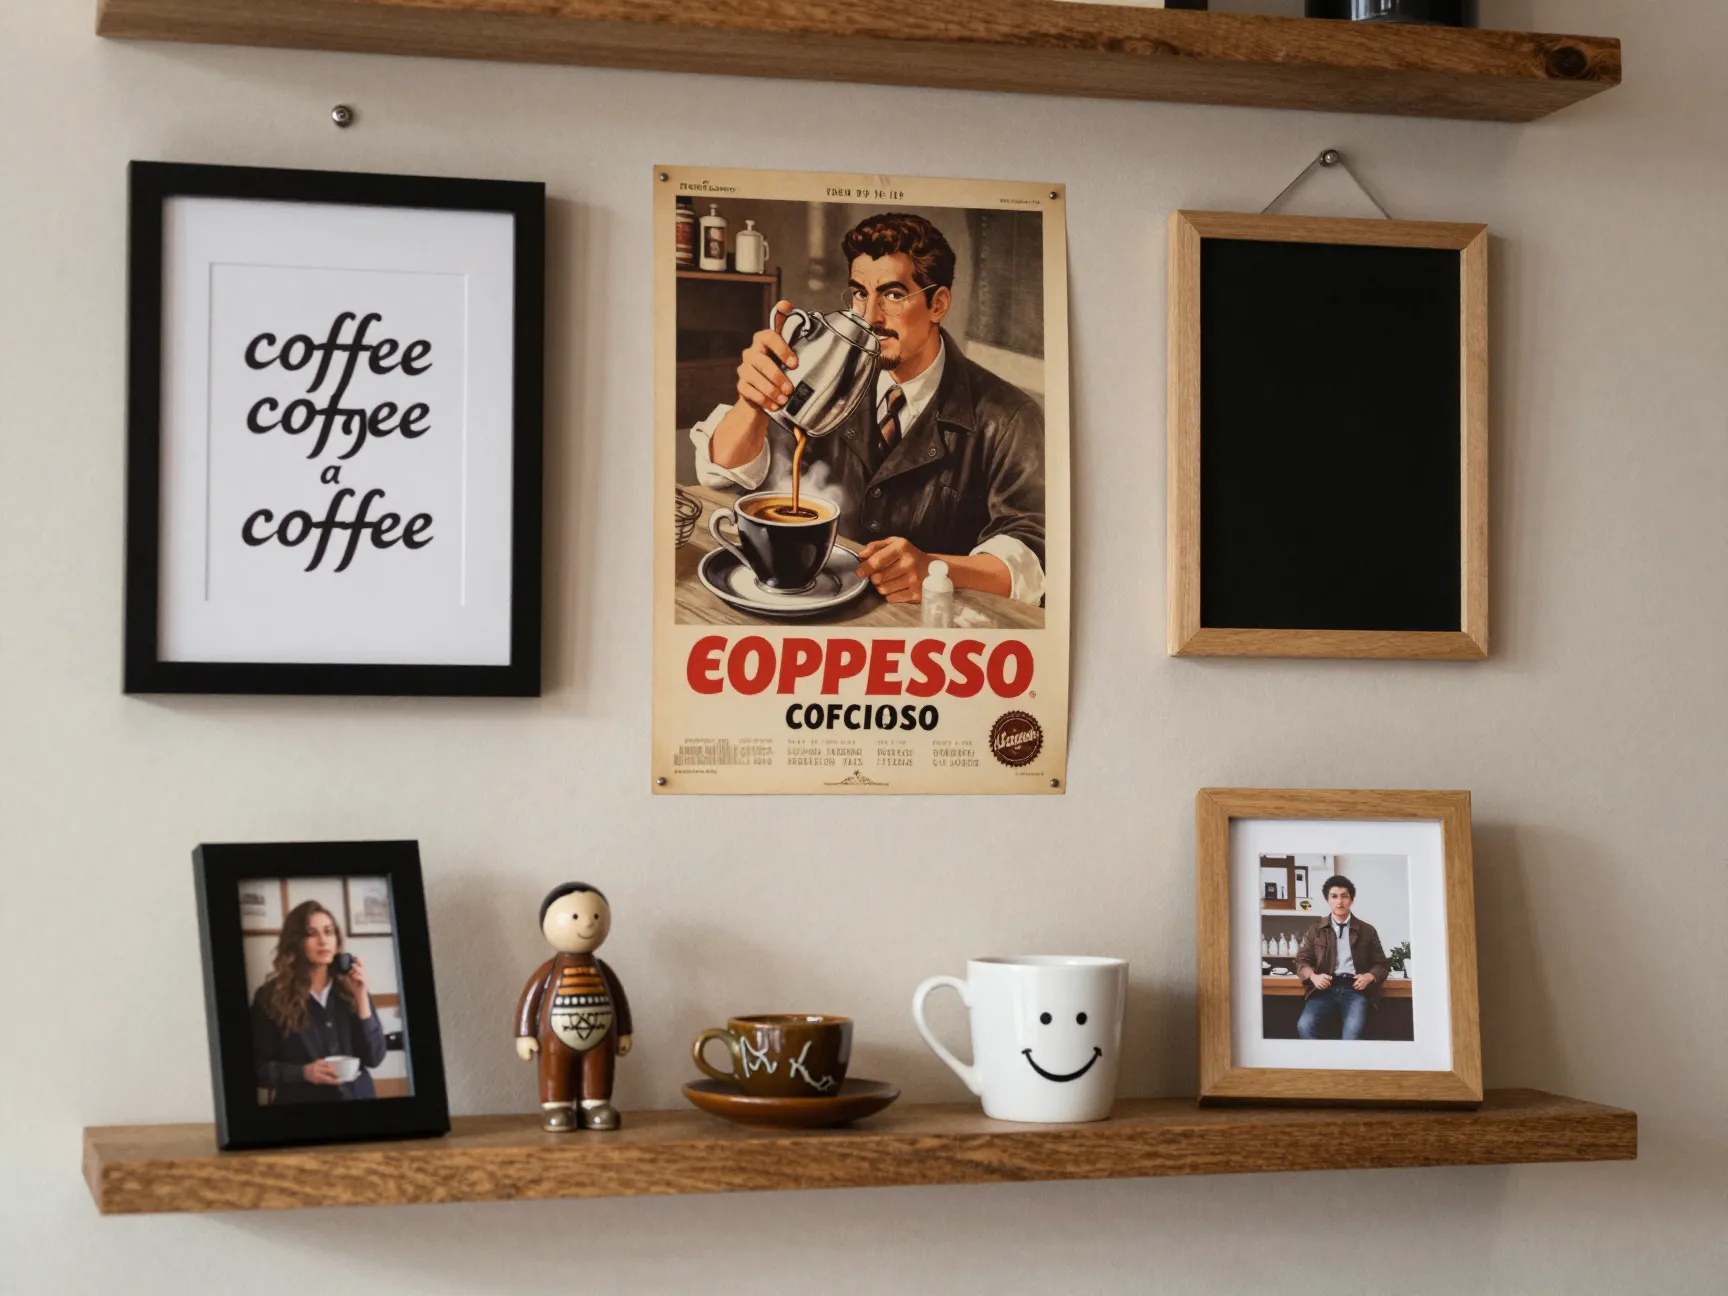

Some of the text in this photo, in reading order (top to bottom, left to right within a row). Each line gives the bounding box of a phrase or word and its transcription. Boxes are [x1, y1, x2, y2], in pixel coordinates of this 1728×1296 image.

[245, 311, 432, 394] coffee
[320, 465, 341, 484] a
[242, 487, 433, 573] coffee
[686, 634, 1034, 700] EOPPESSO
[785, 703, 939, 731] COFCIOSO
